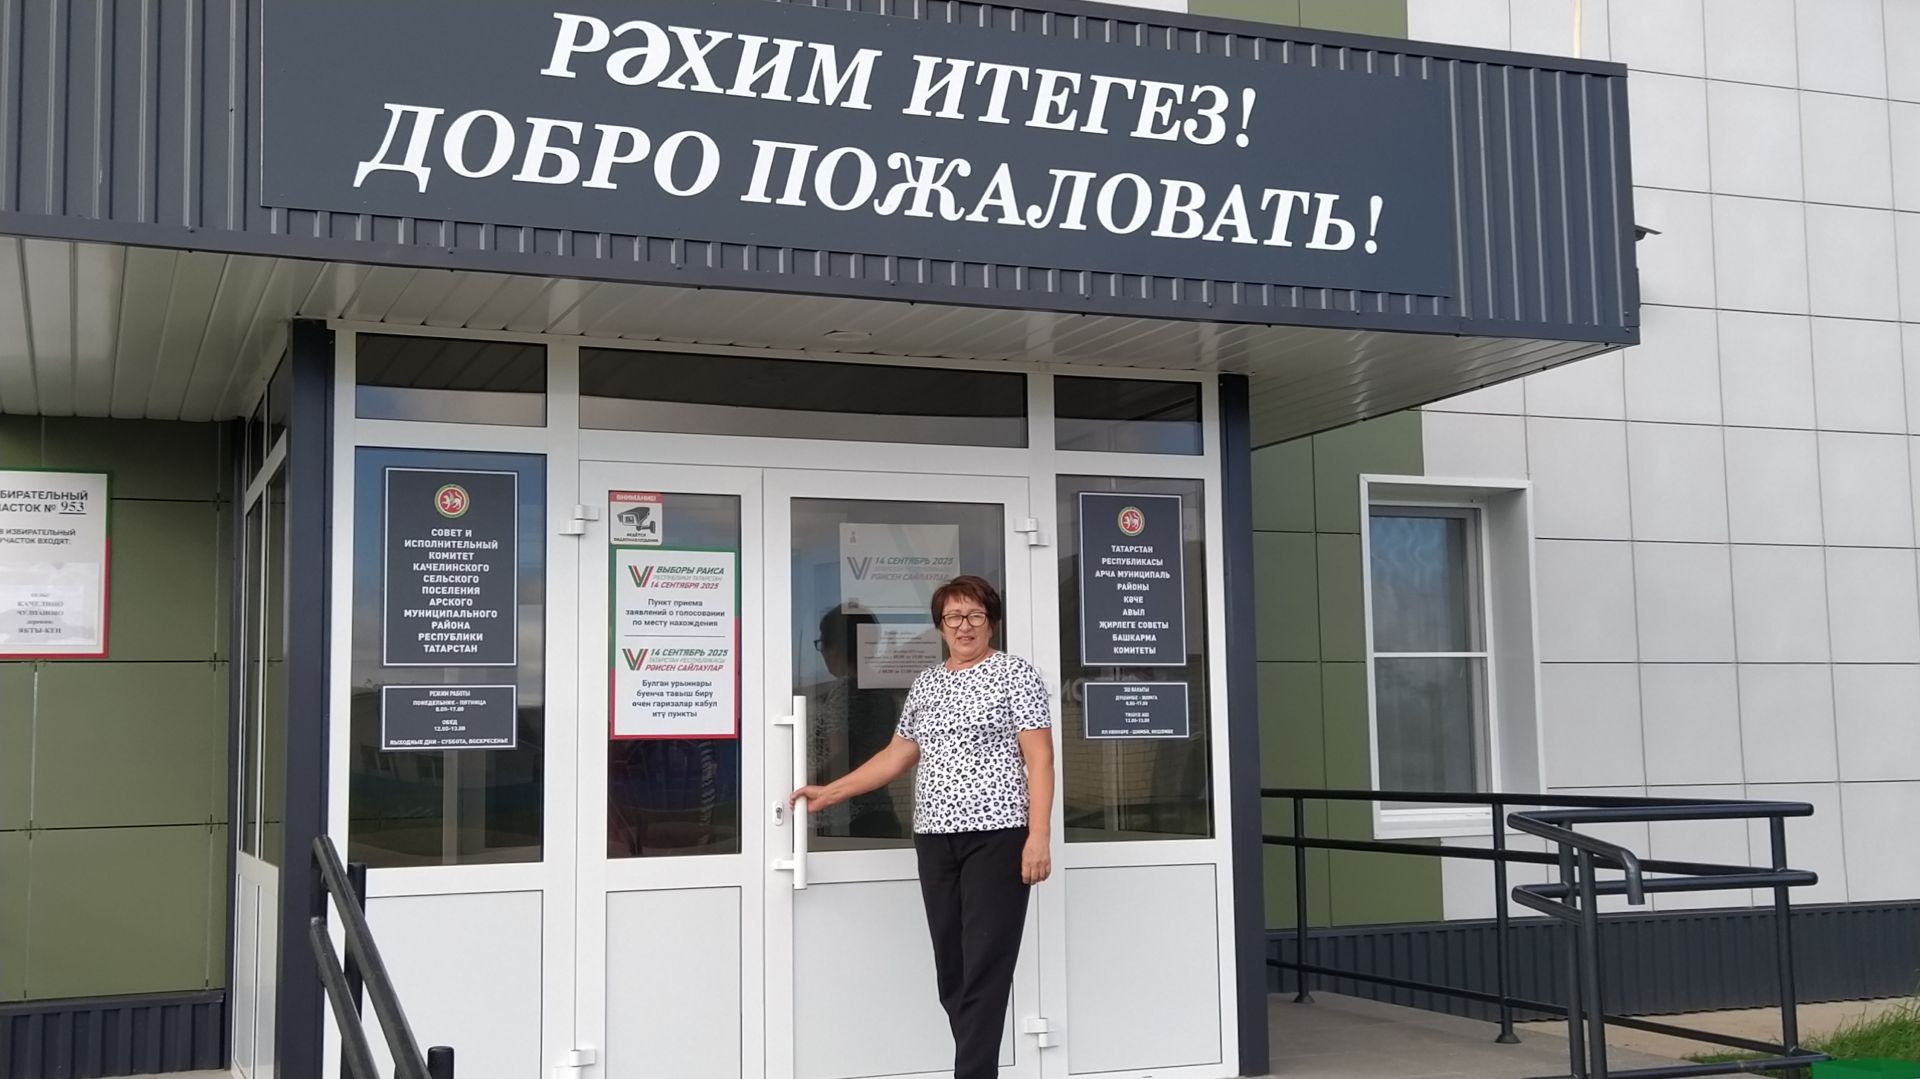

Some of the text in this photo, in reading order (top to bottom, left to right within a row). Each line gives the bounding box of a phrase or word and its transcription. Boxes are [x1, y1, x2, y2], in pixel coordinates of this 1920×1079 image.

[540, 11, 1256, 145] РӘХИМ ИТЕГЕЗ!
[352, 102, 1383, 254] ДОБРО ПОЖАЛОВАТЬ!
[0, 489, 88, 501] БИРАТЕЛЬНЫЙ
[0, 501, 85, 513] АСТОК № 953
[6, 528, 76, 536] ИЗБИРАТЕЛЬНЫЙ
[431, 529, 472, 537] СОВЕТ И
[404, 539, 498, 550] ИСПОЛНИТЕЛЬНЫЙ
[1111, 545, 1153, 553] ТАТАРСТАН
[428, 552, 474, 560] КОМИТЕТ
[1102, 557, 1164, 566] РЕСПУБЛИКАСЫ
[413, 563, 489, 572] КАЧЕЛИНСКОГО
[656, 566, 724, 575] ВЫБОРЫ РАИСА
[1095, 570, 1171, 579] АРЧА МУНИЦИПАЛЬ
[423, 575, 479, 583] СЕЛЬСКОГО
[422, 586, 480, 594] ПОСЕЛЕНИЯ
[700, 582, 719, 590] 2025
[1117, 582, 1149, 591] РАЙОНЫ
[429, 598, 473, 606] АРСКОГО
[648, 599, 703, 608] Пункт приема
[404, 609, 498, 618] МУНИЦИПАЛЬНОГО
[625, 609, 667, 617] заявлений
[1122, 608, 1146, 616] АВЫЛ
[431, 620, 470, 629] РАЙОНА
[1137, 621, 1169, 629] СОВЕТЫ
[418, 633, 483, 641] РЕСПУБЛИКИ
[1112, 634, 1157, 642] БАШКАРМА
[424, 644, 478, 652] ТАТАРСТАН
[1113, 646, 1157, 654] КОМИТЕТЫ
[707, 649, 728, 657] 2025
[636, 690, 664, 698] буенча
[695, 700, 718, 708] кабул
[652, 711, 697, 719] итү пункты
